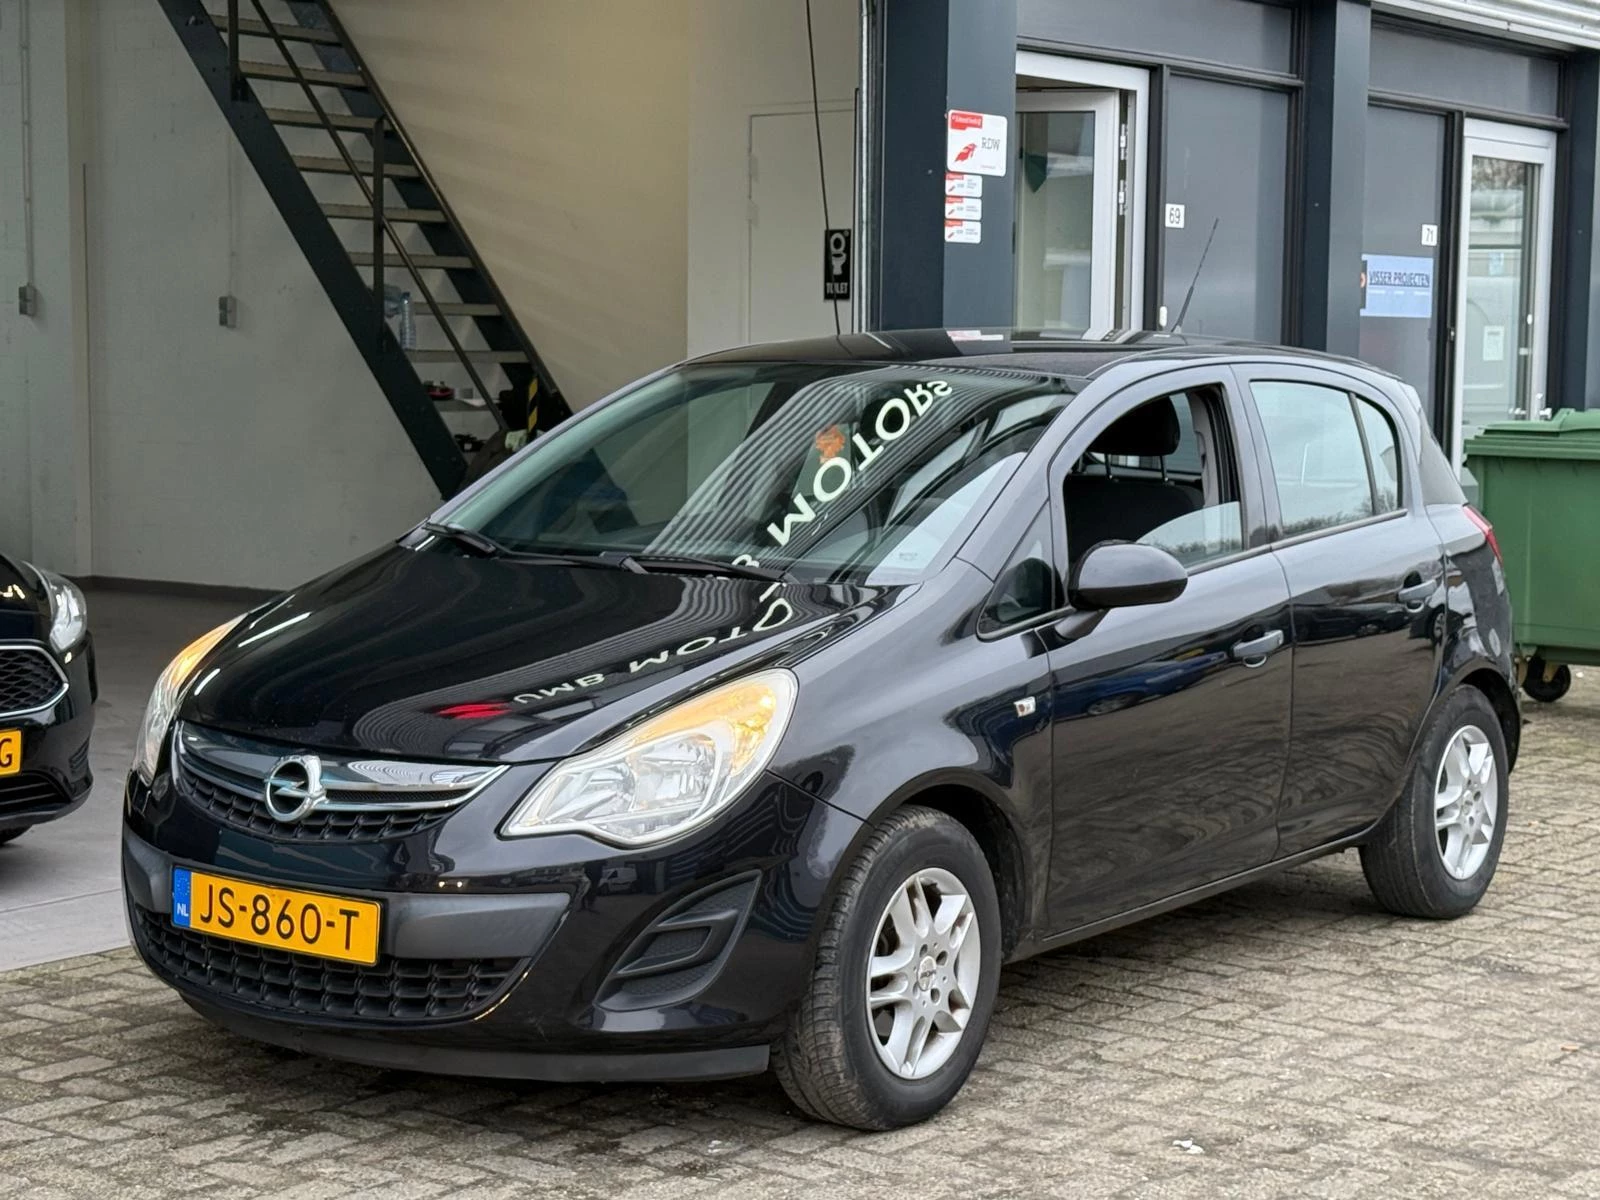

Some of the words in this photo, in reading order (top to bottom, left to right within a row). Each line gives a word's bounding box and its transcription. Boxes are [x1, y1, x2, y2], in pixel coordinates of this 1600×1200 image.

[981, 137, 1001, 151] RDW
[1169, 207, 1181, 224] 69
[1425, 227, 1434, 243] 71
[1368, 270, 1392, 285] VISSER
[1394, 271, 1431, 287] PROJECTEN
[176, 903, 189, 917] NL
[199, 883, 360, 951] JS-860-T
